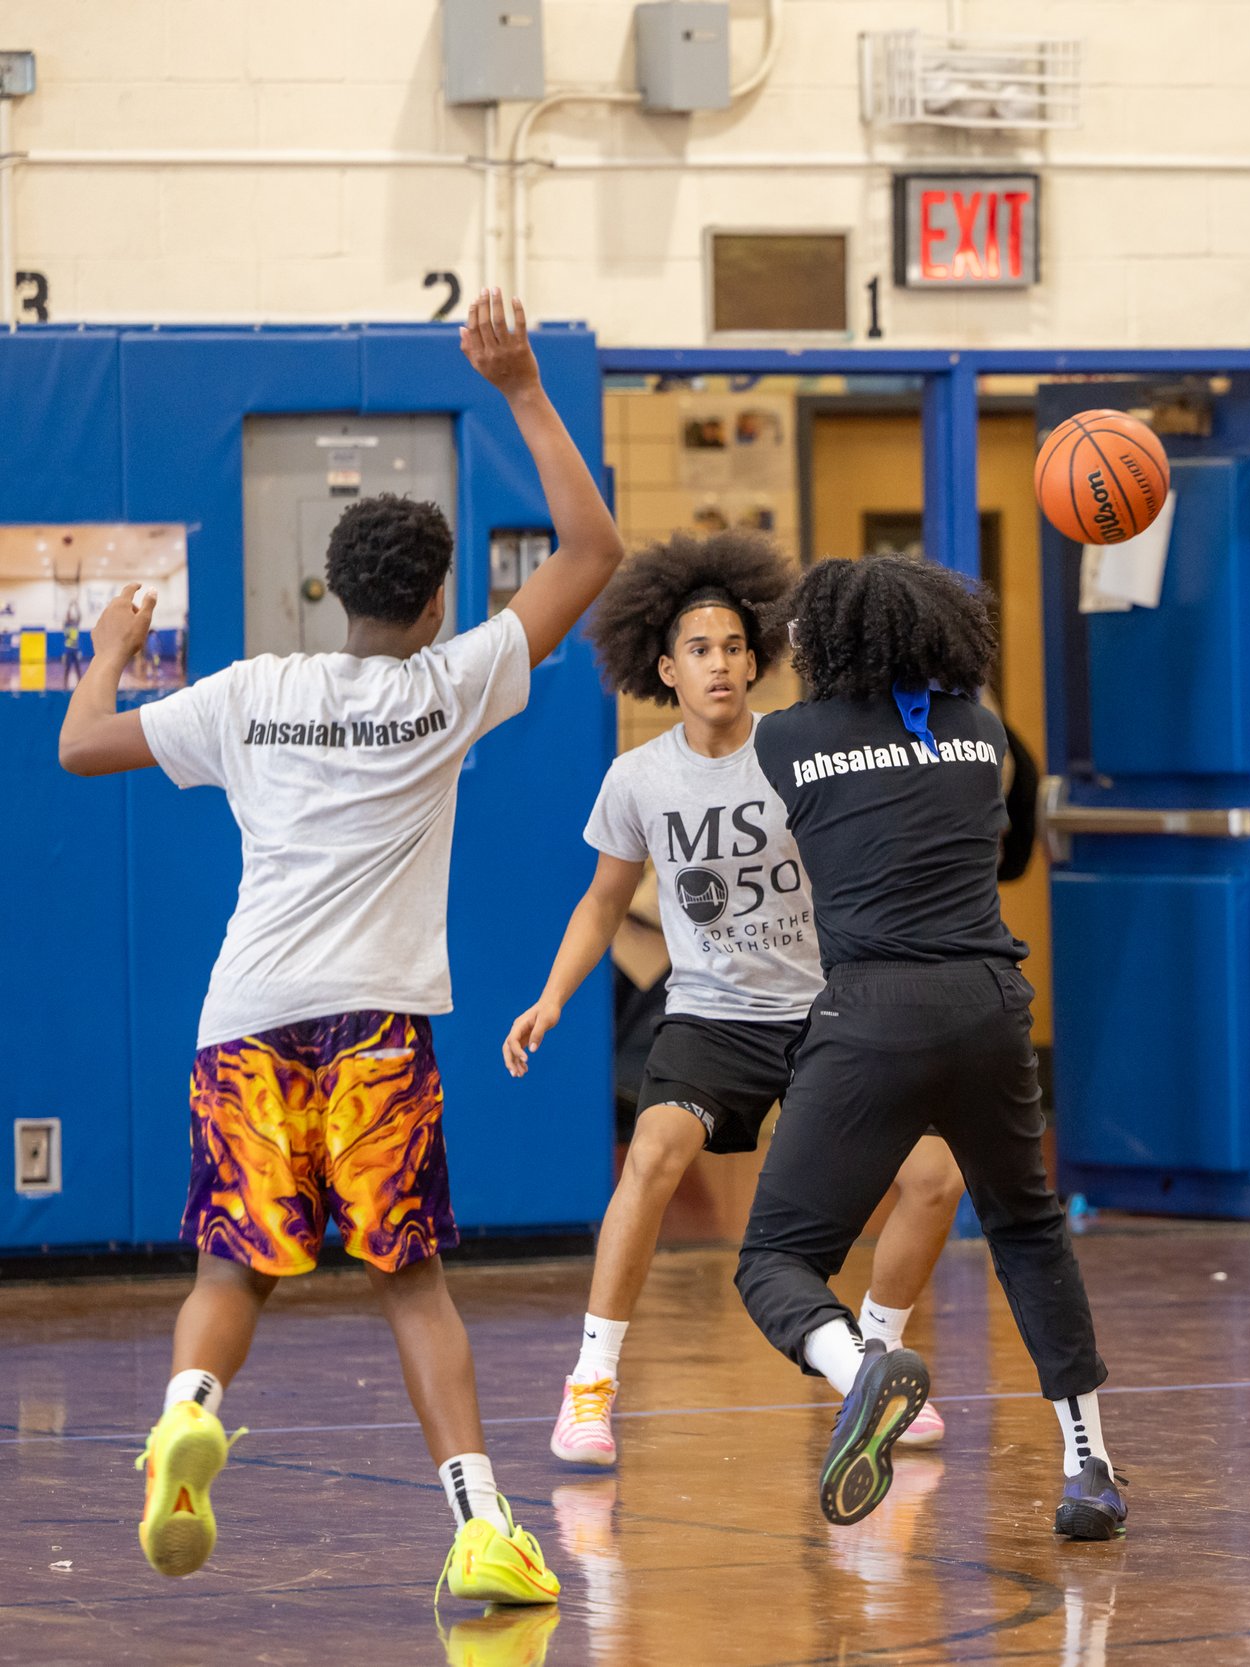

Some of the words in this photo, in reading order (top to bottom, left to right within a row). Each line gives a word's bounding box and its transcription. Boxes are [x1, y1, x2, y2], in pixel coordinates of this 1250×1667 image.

[920, 190, 1031, 281] EXIT
[15, 271, 49, 324] 3
[423, 271, 462, 322] 2
[866, 275, 883, 339] 1
[1088, 469, 1127, 543] Wilson
[243, 718, 347, 748] Jahsaiah
[351, 708, 448, 747] Watson
[792, 743, 910, 788] Jahsaiah
[910, 737, 999, 766] Watson
[662, 800, 768, 863] MS
[732, 859, 802, 918] 50
[743, 920, 771, 938] OF
[777, 910, 811, 931] THE
